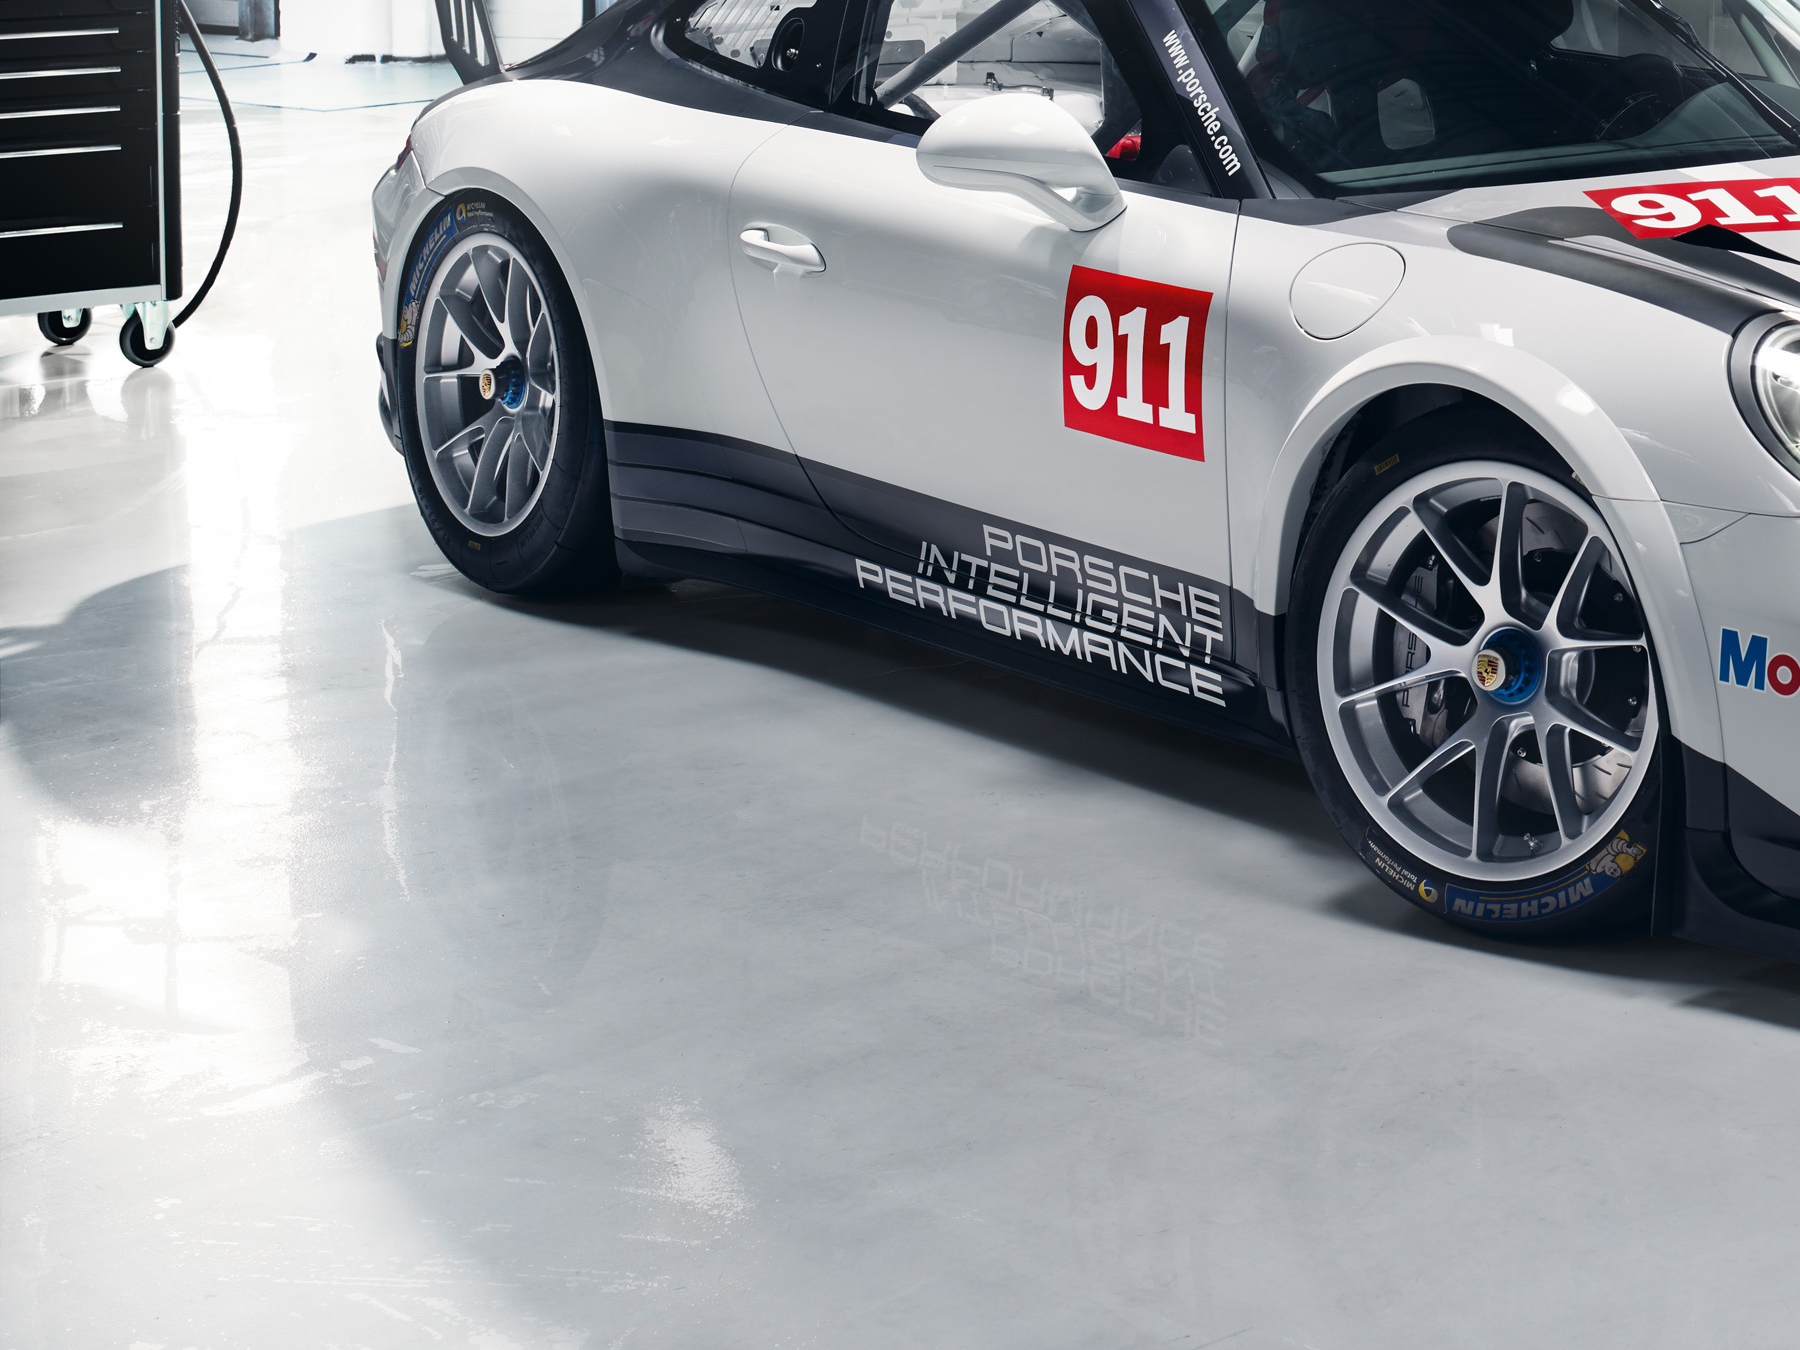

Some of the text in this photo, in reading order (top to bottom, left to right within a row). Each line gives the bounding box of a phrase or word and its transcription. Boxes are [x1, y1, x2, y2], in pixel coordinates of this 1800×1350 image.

[1162, 29, 1243, 178] www.porsche.com
[409, 212, 452, 295] MICHELIN
[1068, 294, 1198, 435] 911
[917, 540, 1224, 665] INTELLIGENT
[982, 524, 1223, 629] PORSCHE
[855, 558, 1227, 708] PERFORMANCE
[1373, 856, 1416, 892] MICHELIN
[1400, 868, 1418, 884] Total
[1452, 875, 1595, 920] MICHELIN
